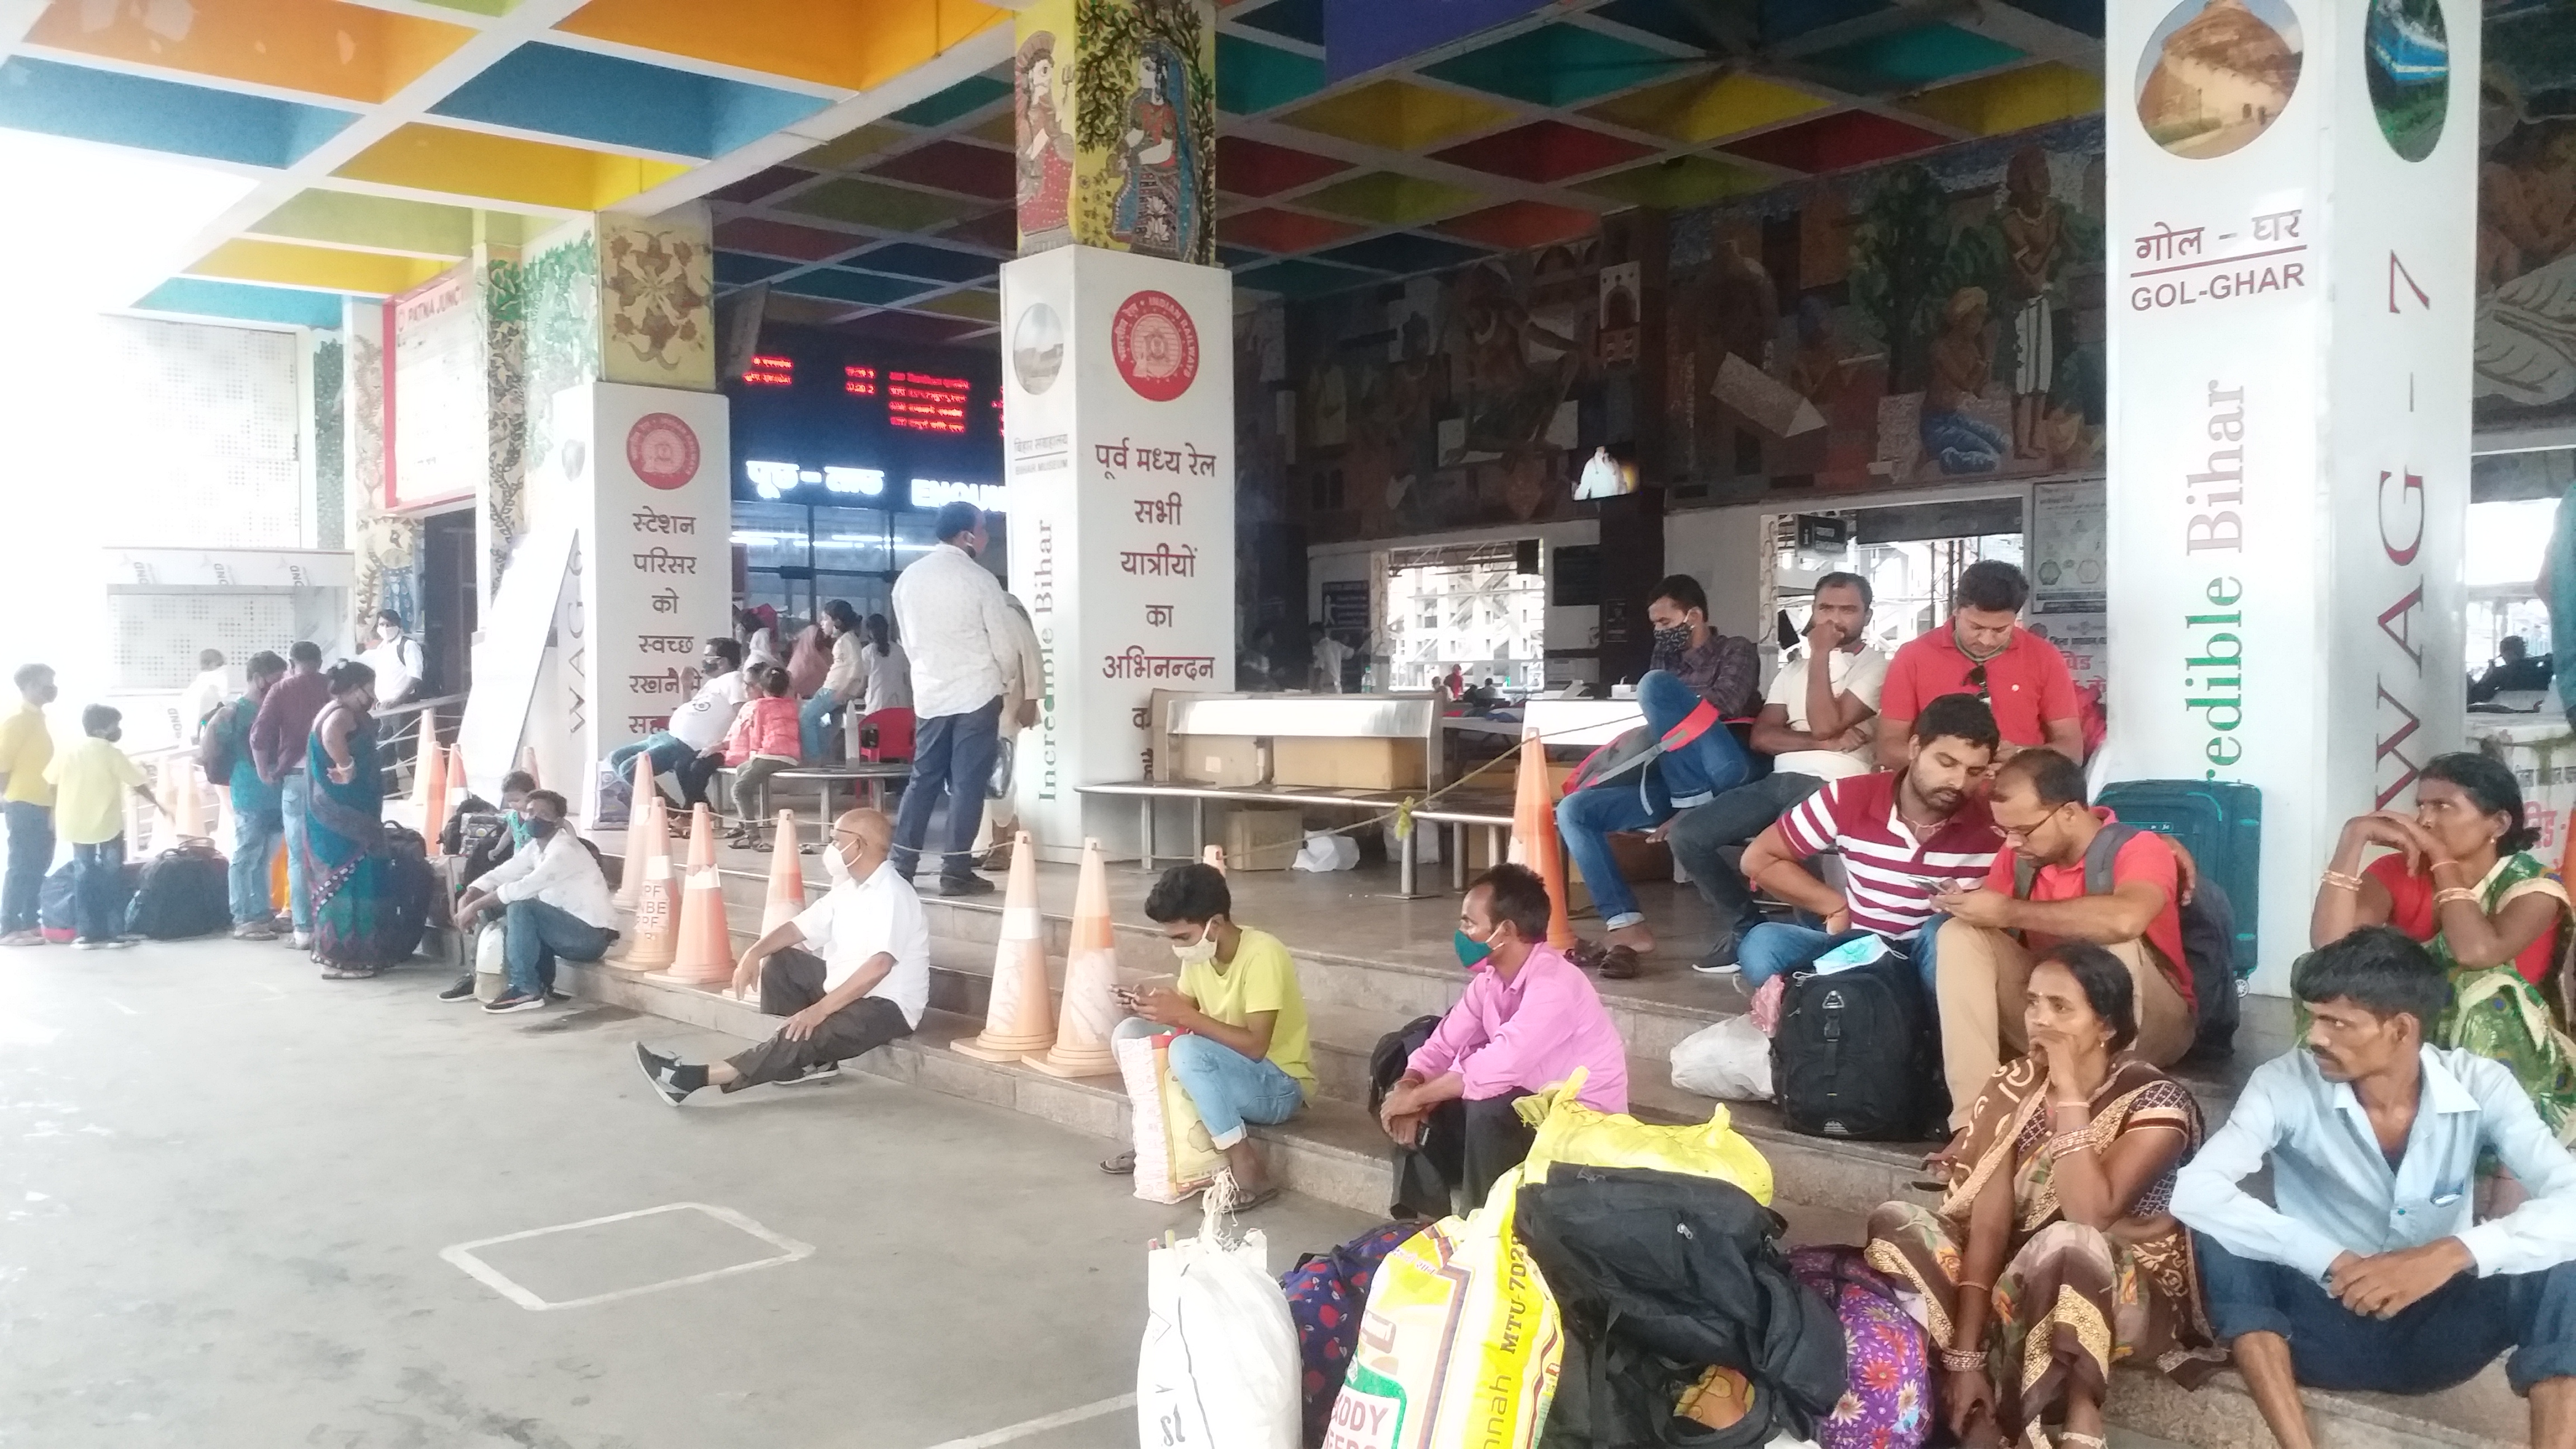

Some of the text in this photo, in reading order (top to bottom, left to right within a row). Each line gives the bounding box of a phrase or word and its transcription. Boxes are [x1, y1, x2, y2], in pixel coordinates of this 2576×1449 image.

[2135, 221, 2205, 263] गोल
[2252, 209, 2302, 242] घर
[2130, 263, 2305, 312] GOL-GHAR
[1095, 437, 1217, 479] पूर्व मध्य रेल
[2185, 380, 2246, 557] Bihar
[632, 505, 697, 535] स्टेशन
[1134, 492, 1183, 526] सभी
[633, 546, 697, 574] परिसर
[1034, 519, 1053, 614] Bihar
[1120, 543, 1198, 577] यात्रीयों
[651, 587, 679, 614] को
[1145, 604, 1175, 628] का
[638, 634, 694, 654] स्वच्छ
[1102, 645, 1215, 680] अभिनन्दन
[628, 667, 680, 694] रखने
